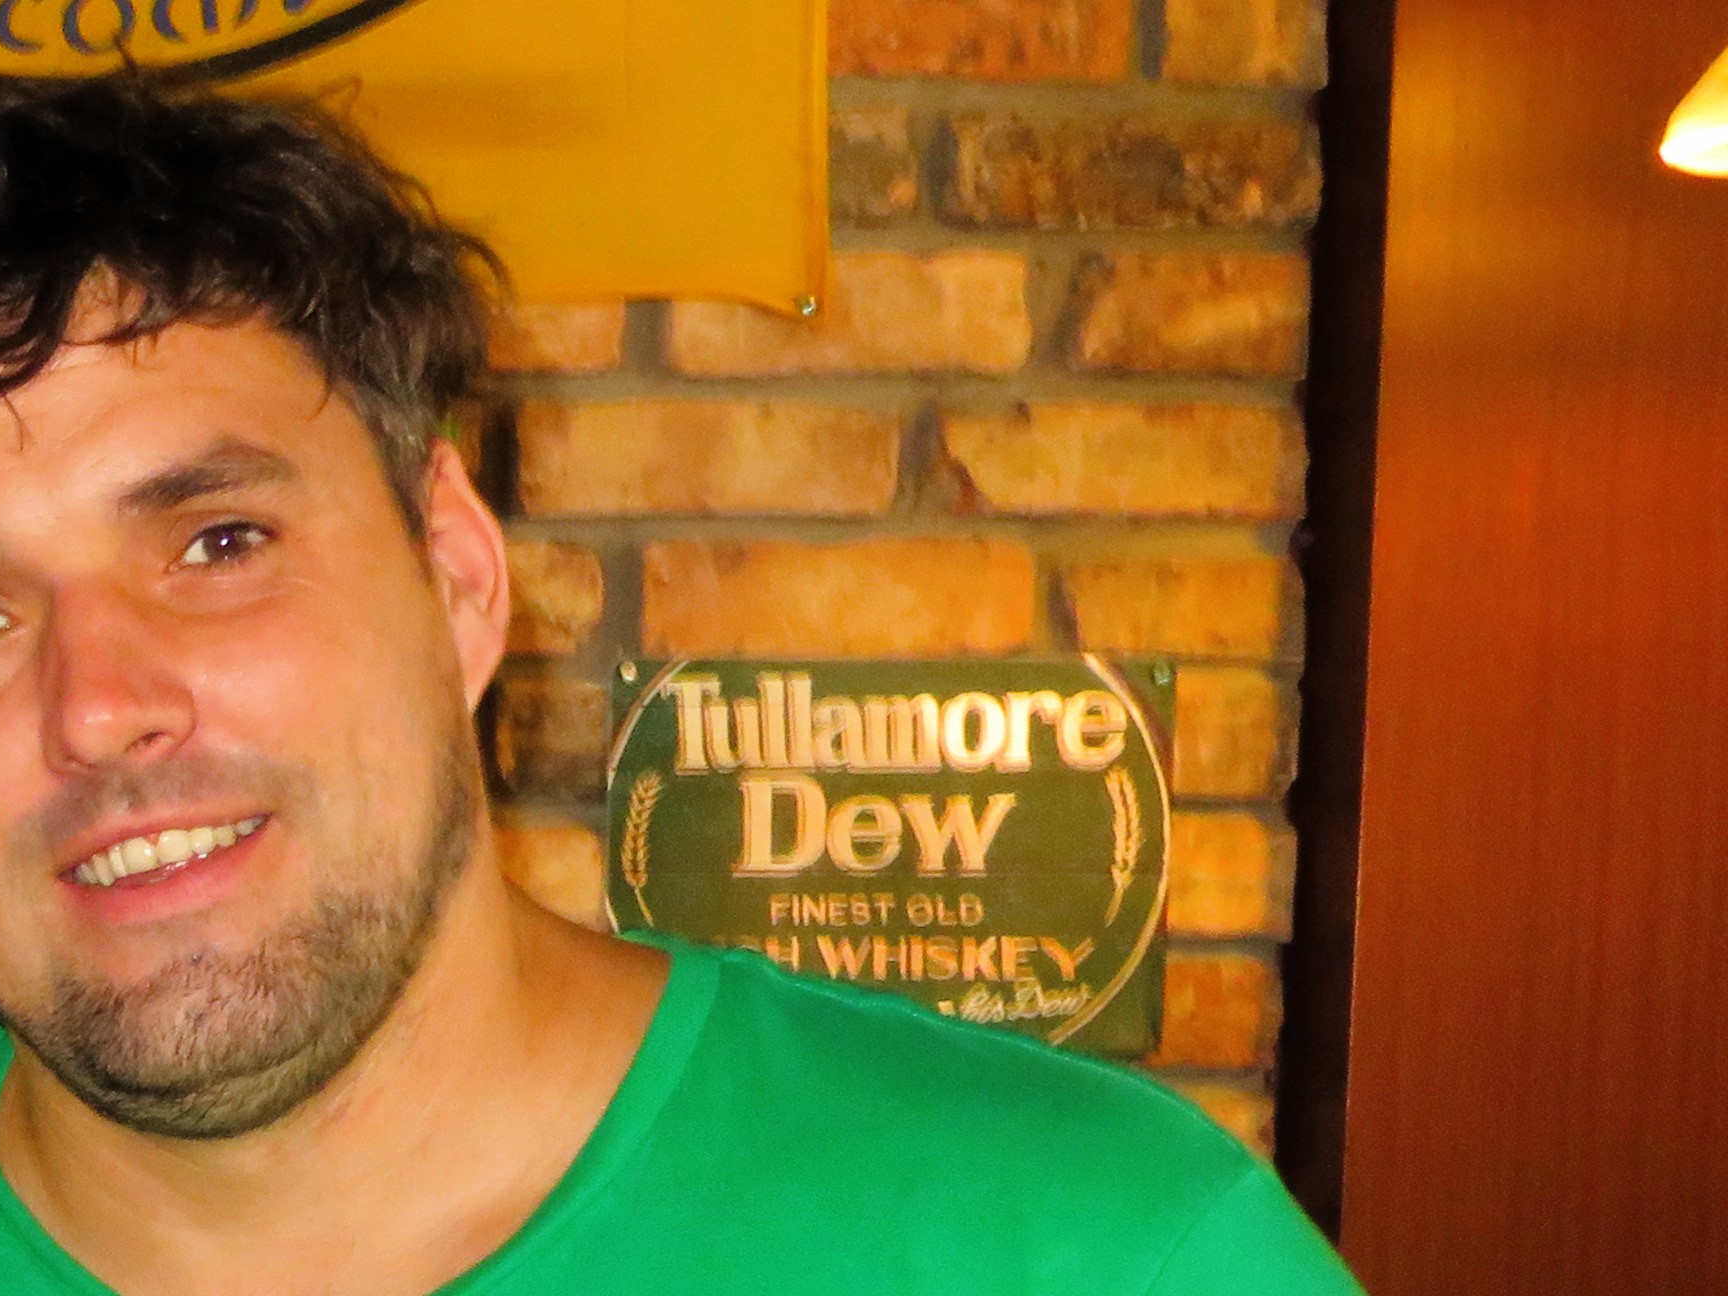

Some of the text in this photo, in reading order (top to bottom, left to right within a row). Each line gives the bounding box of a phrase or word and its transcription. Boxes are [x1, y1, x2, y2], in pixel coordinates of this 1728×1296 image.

[659, 671, 1128, 775] Tullamore
[732, 774, 1016, 878] Dew
[767, 892, 984, 927] FINEST OLD
[816, 935, 1096, 982] WHISKEY
